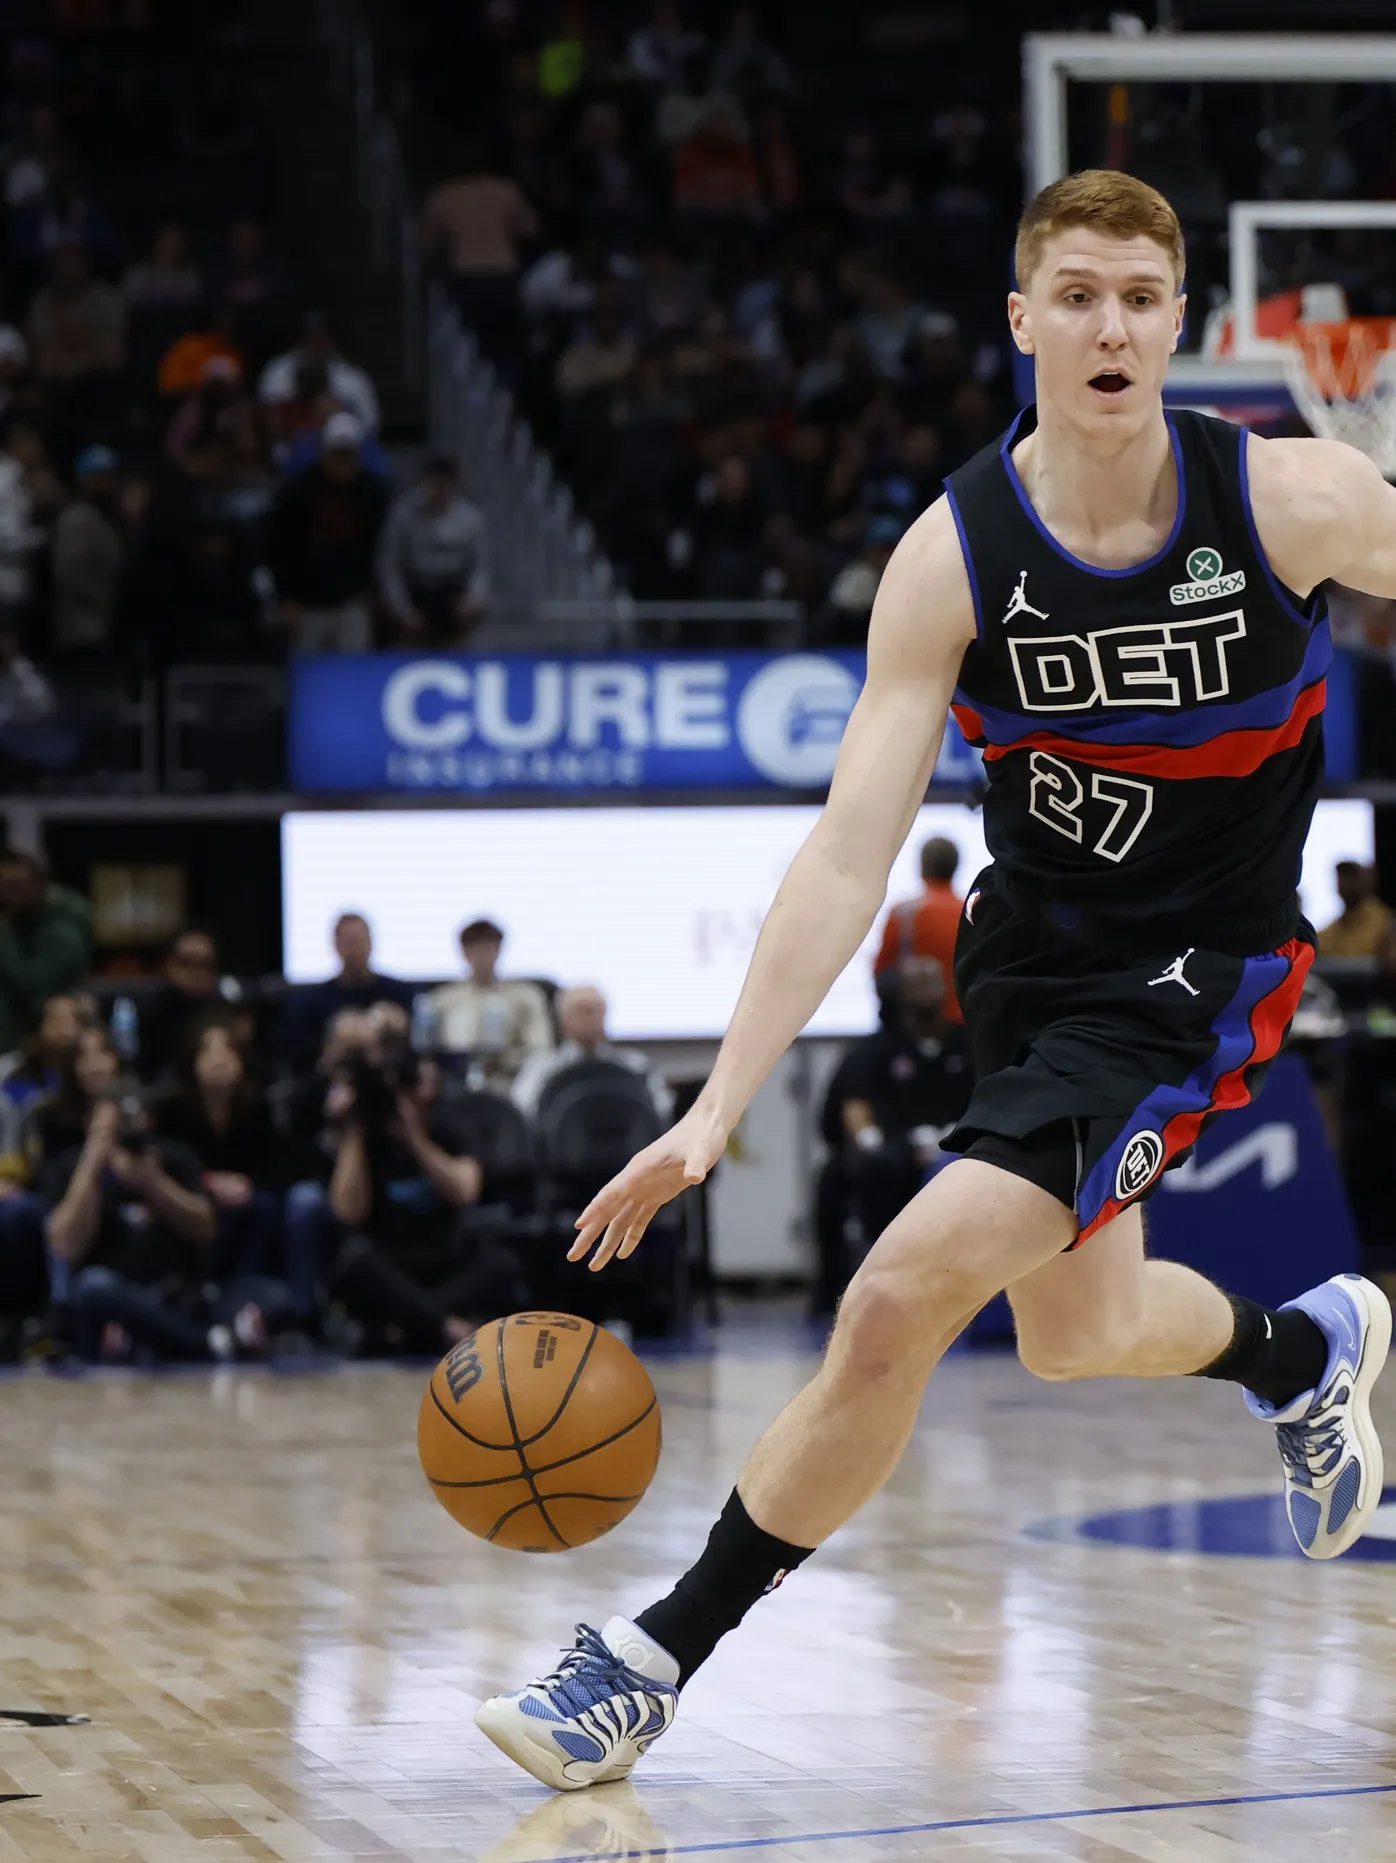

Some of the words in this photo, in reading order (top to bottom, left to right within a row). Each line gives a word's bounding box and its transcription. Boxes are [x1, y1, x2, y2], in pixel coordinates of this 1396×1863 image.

[1172, 573, 1244, 602] StockX
[382, 659, 730, 748] CURE
[1007, 609, 1247, 711] DET
[1029, 751, 1153, 863] 27
